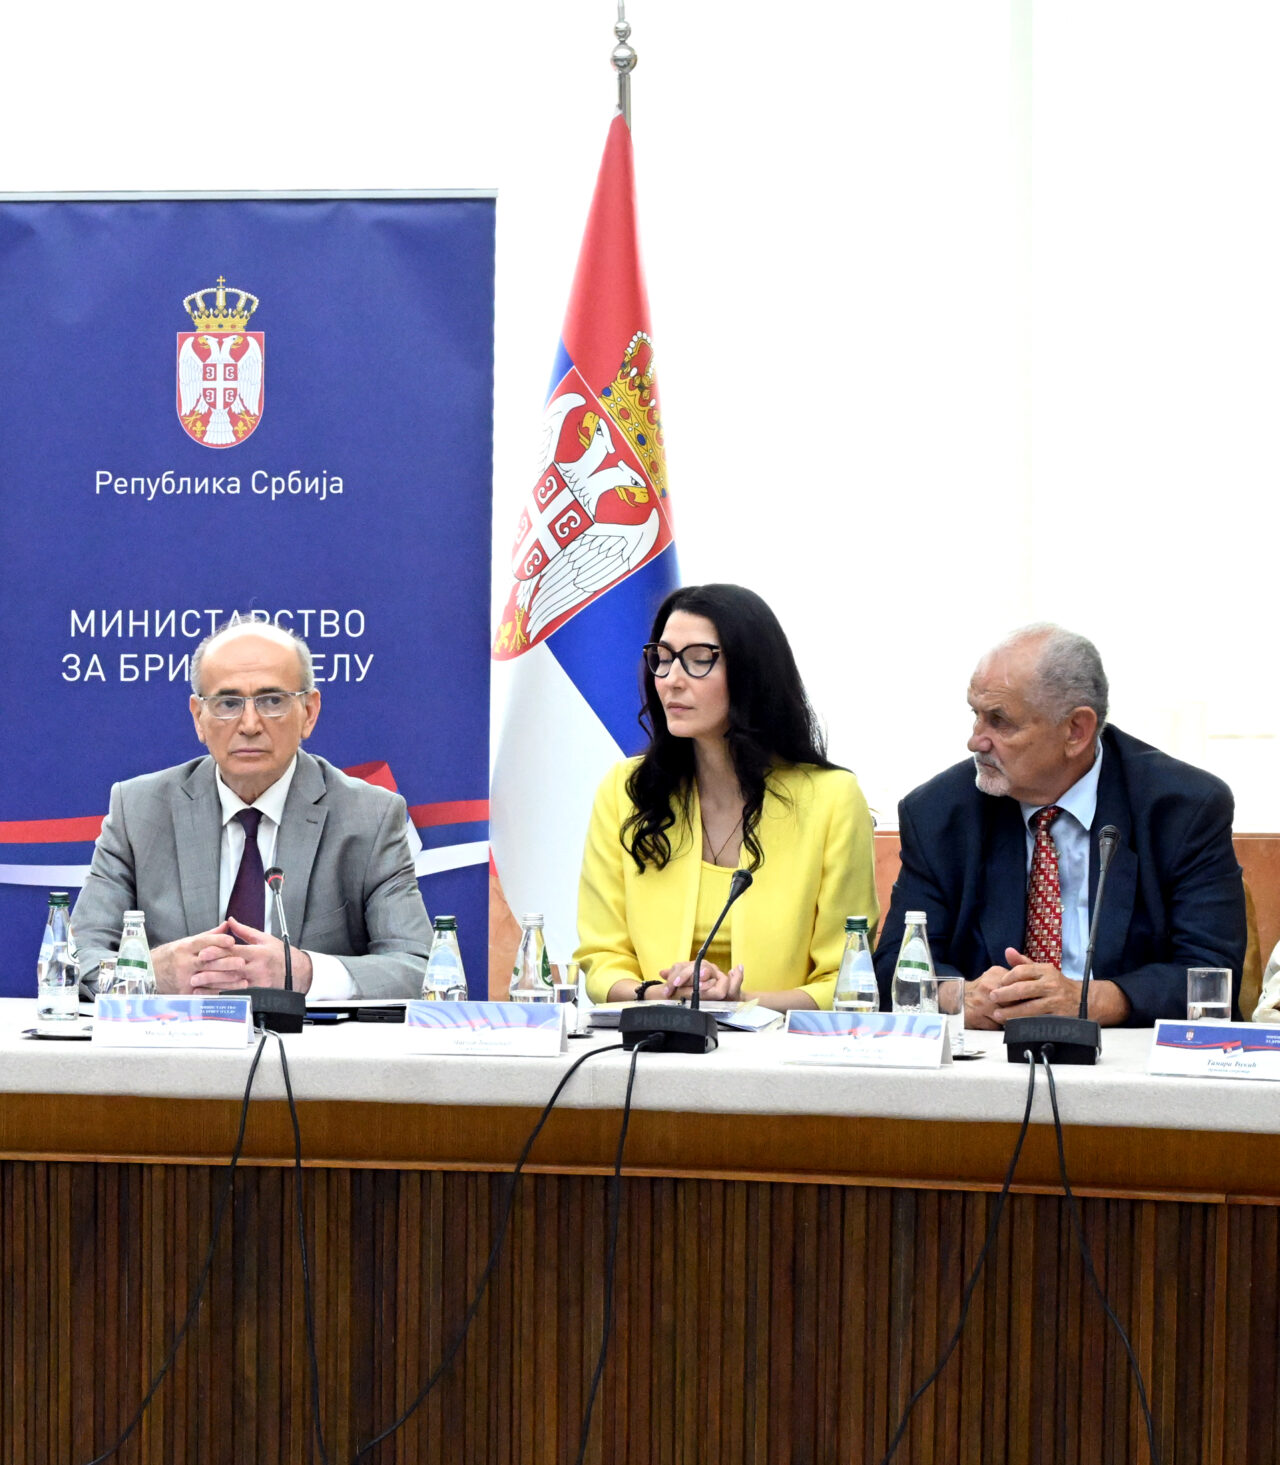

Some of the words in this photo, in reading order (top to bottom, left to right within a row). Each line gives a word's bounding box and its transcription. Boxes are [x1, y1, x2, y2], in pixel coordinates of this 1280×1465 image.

[95, 470, 241, 501] Република
[251, 470, 344, 501] Србија
[61, 653, 107, 682] ЗА
[119, 653, 191, 682] БРИ
[311, 653, 375, 682] ЕЛУ
[1018, 1023, 1082, 1039] PHILIPS
